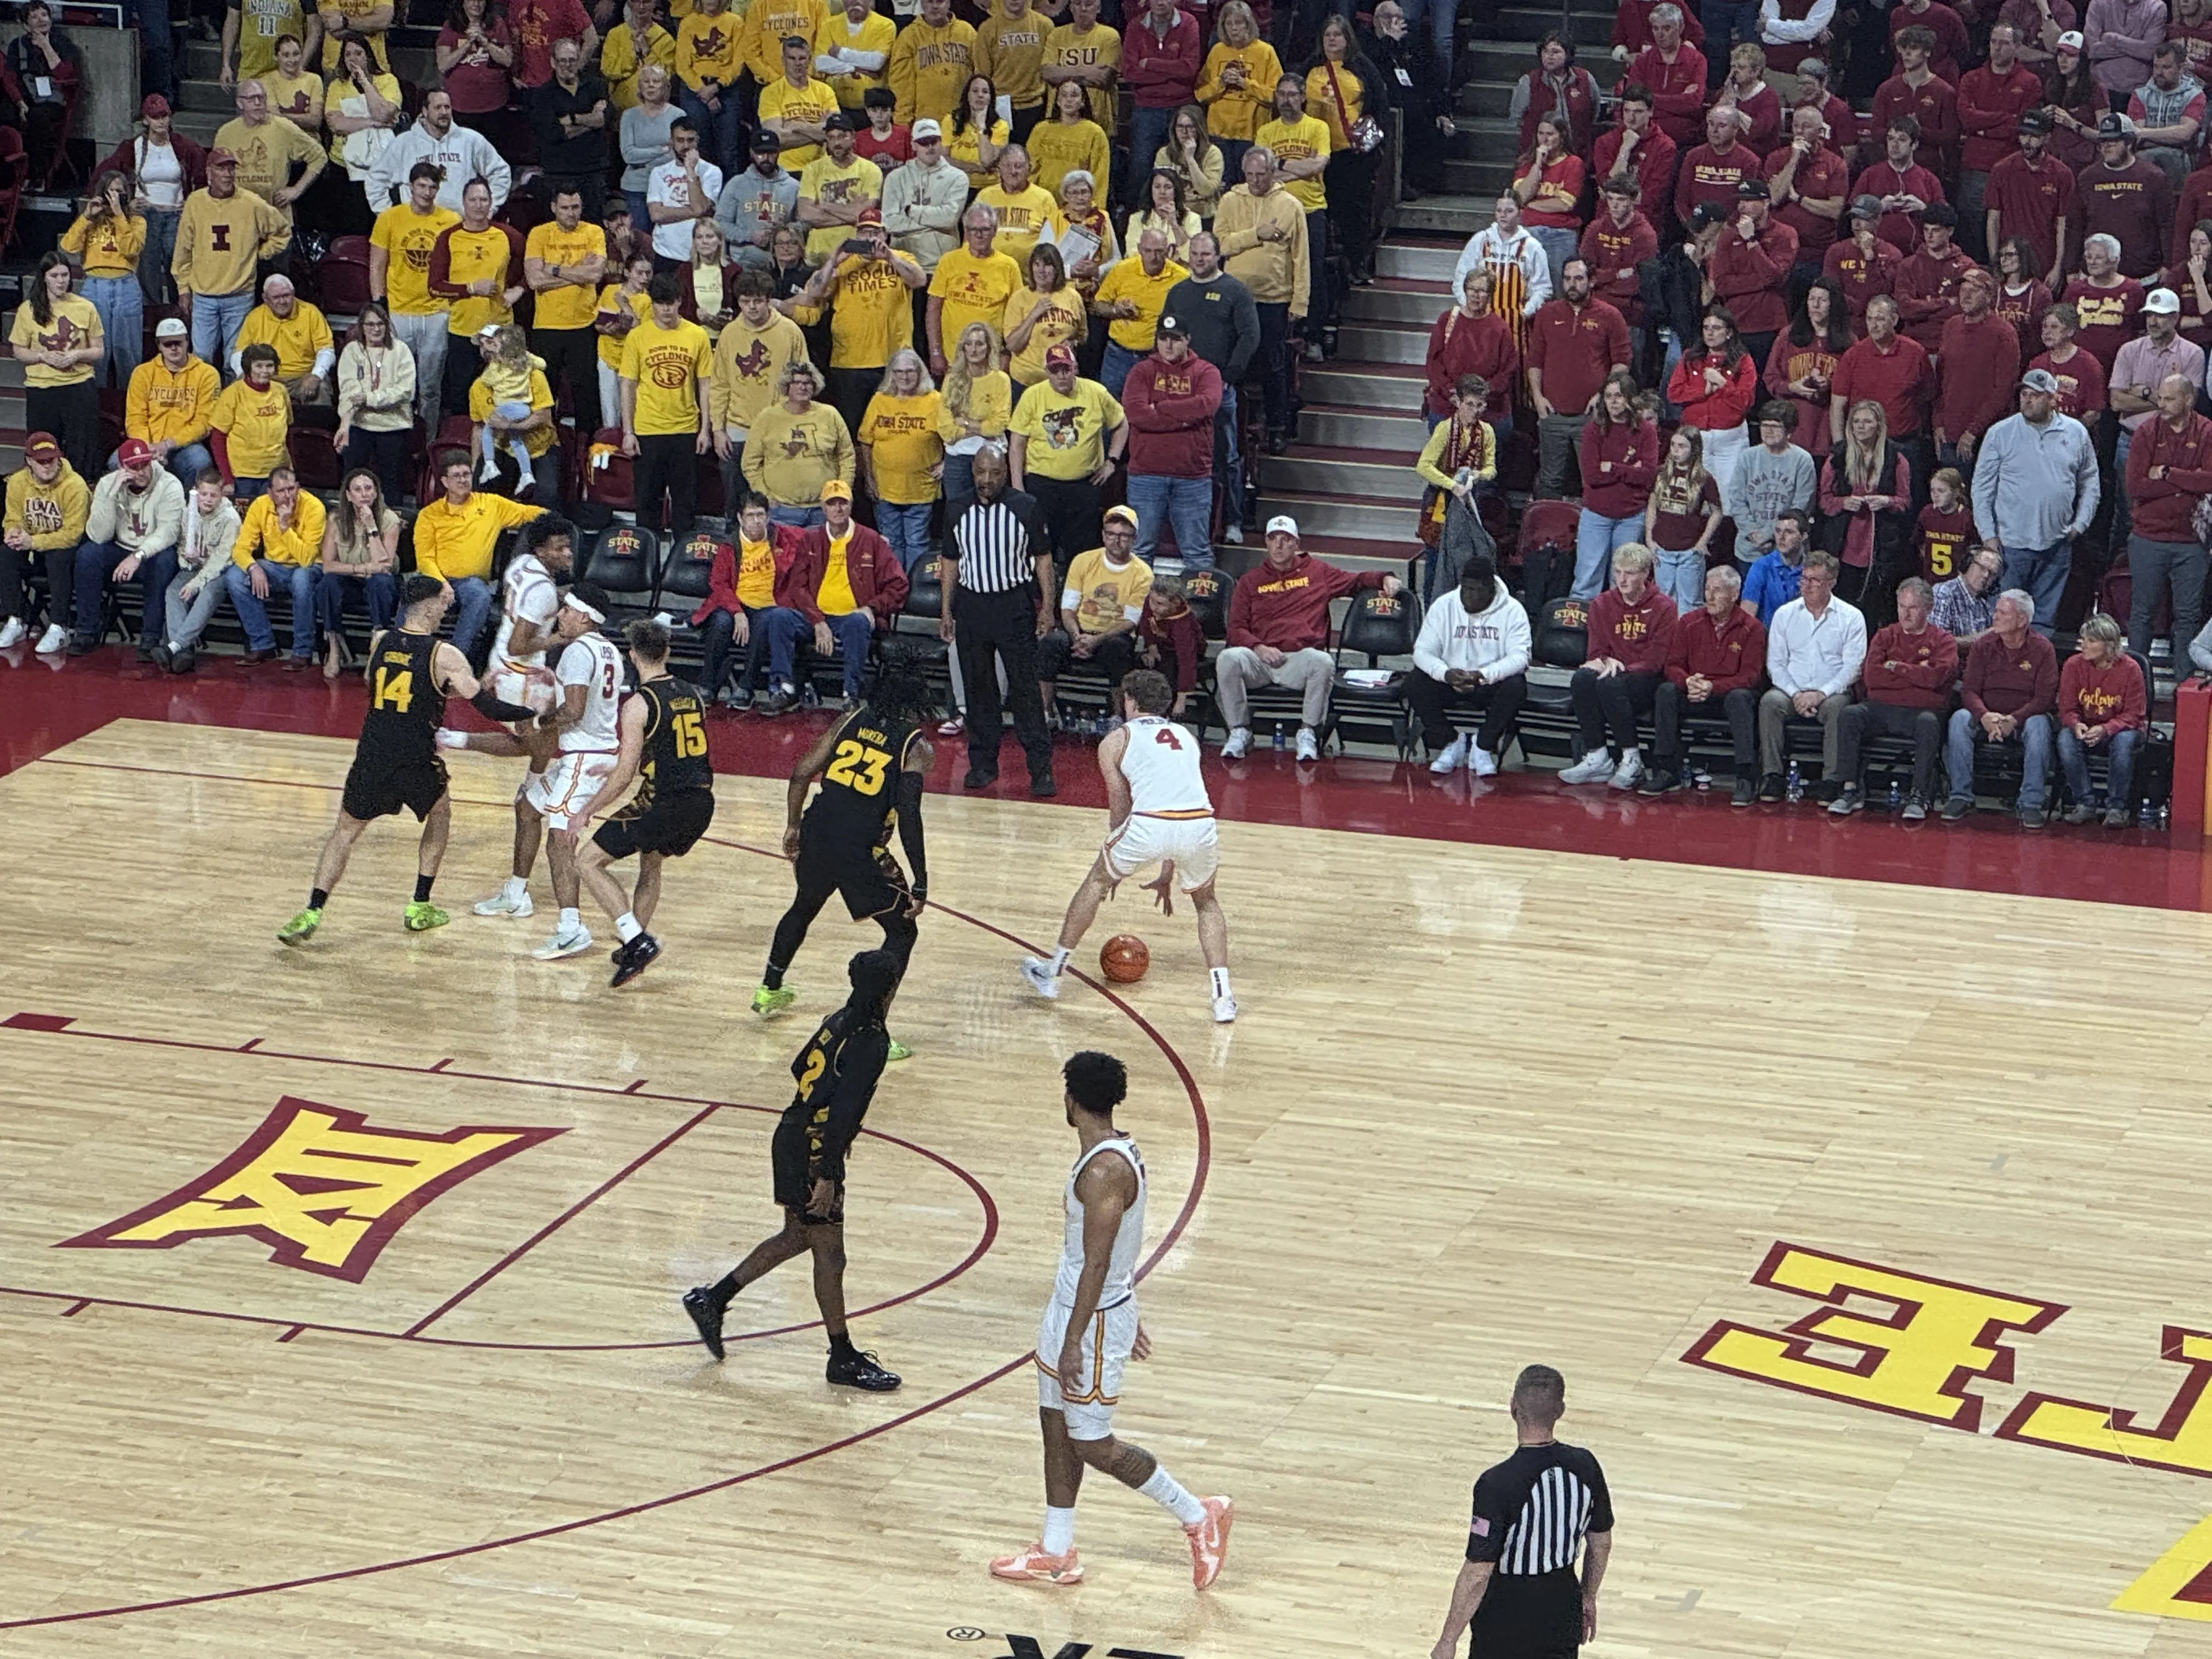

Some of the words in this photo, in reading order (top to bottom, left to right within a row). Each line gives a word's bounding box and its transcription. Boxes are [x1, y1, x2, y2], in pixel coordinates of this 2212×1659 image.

[258, 16, 276, 35] 11
[761, 17, 809, 32] CYCLONES
[998, 32, 1039, 48] STATE
[918, 44, 942, 70] IOWA
[1057, 47, 1098, 66] ISU
[438, 153, 461, 163] STATE
[234, 176, 273, 184] YCLONES
[2117, 182, 2143, 191] STATE
[743, 201, 787, 214] STATE
[212, 225, 230, 251] I
[847, 264, 895, 282] GOOD
[848, 276, 898, 295] TIMES
[645, 353, 693, 365] CYCLONES
[148, 387, 195, 403] CYCLONES
[898, 416, 927, 430] STATE
[1747, 474, 1768, 493] IOWA
[607, 536, 640, 551] STATE
[685, 541, 718, 555] STATE
[1931, 543, 1953, 575] 5
[1186, 578, 1219, 593] STATE
[1257, 580, 1284, 594] IOWA
[1284, 577, 1310, 591] STATE
[1367, 597, 1401, 611] STATE
[1553, 608, 1588, 623] STATE
[1470, 626, 1499, 641] STATE
[374, 666, 413, 713] 14
[602, 664, 614, 699] 3
[672, 712, 708, 758] 15
[1155, 729, 1183, 751] 4
[825, 738, 893, 797] 23
[799, 1048, 826, 1103] 2
